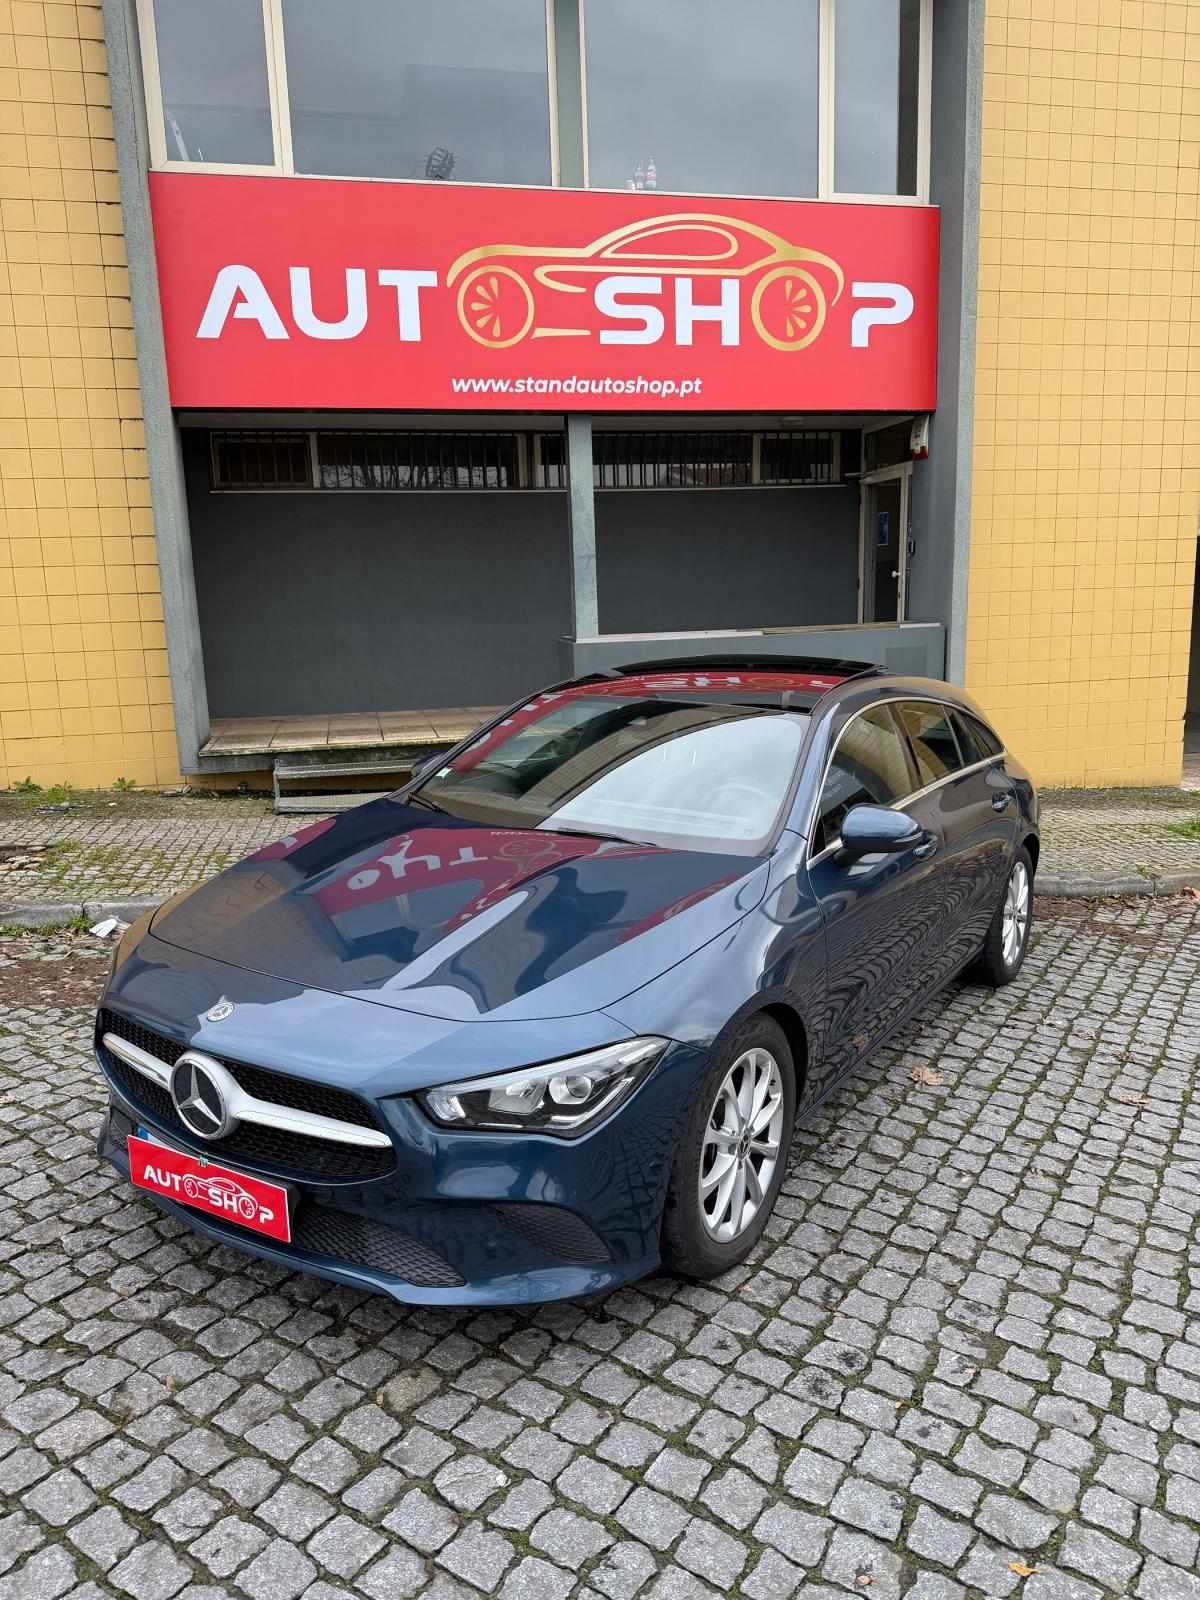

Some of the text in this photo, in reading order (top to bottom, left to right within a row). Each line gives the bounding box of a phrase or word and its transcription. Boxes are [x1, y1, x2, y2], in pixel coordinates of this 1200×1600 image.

[196, 264, 915, 352] AUTO SHOP
[451, 376, 702, 398] www.standautoshop.pt
[144, 1165, 274, 1223] AUTO SHOP
